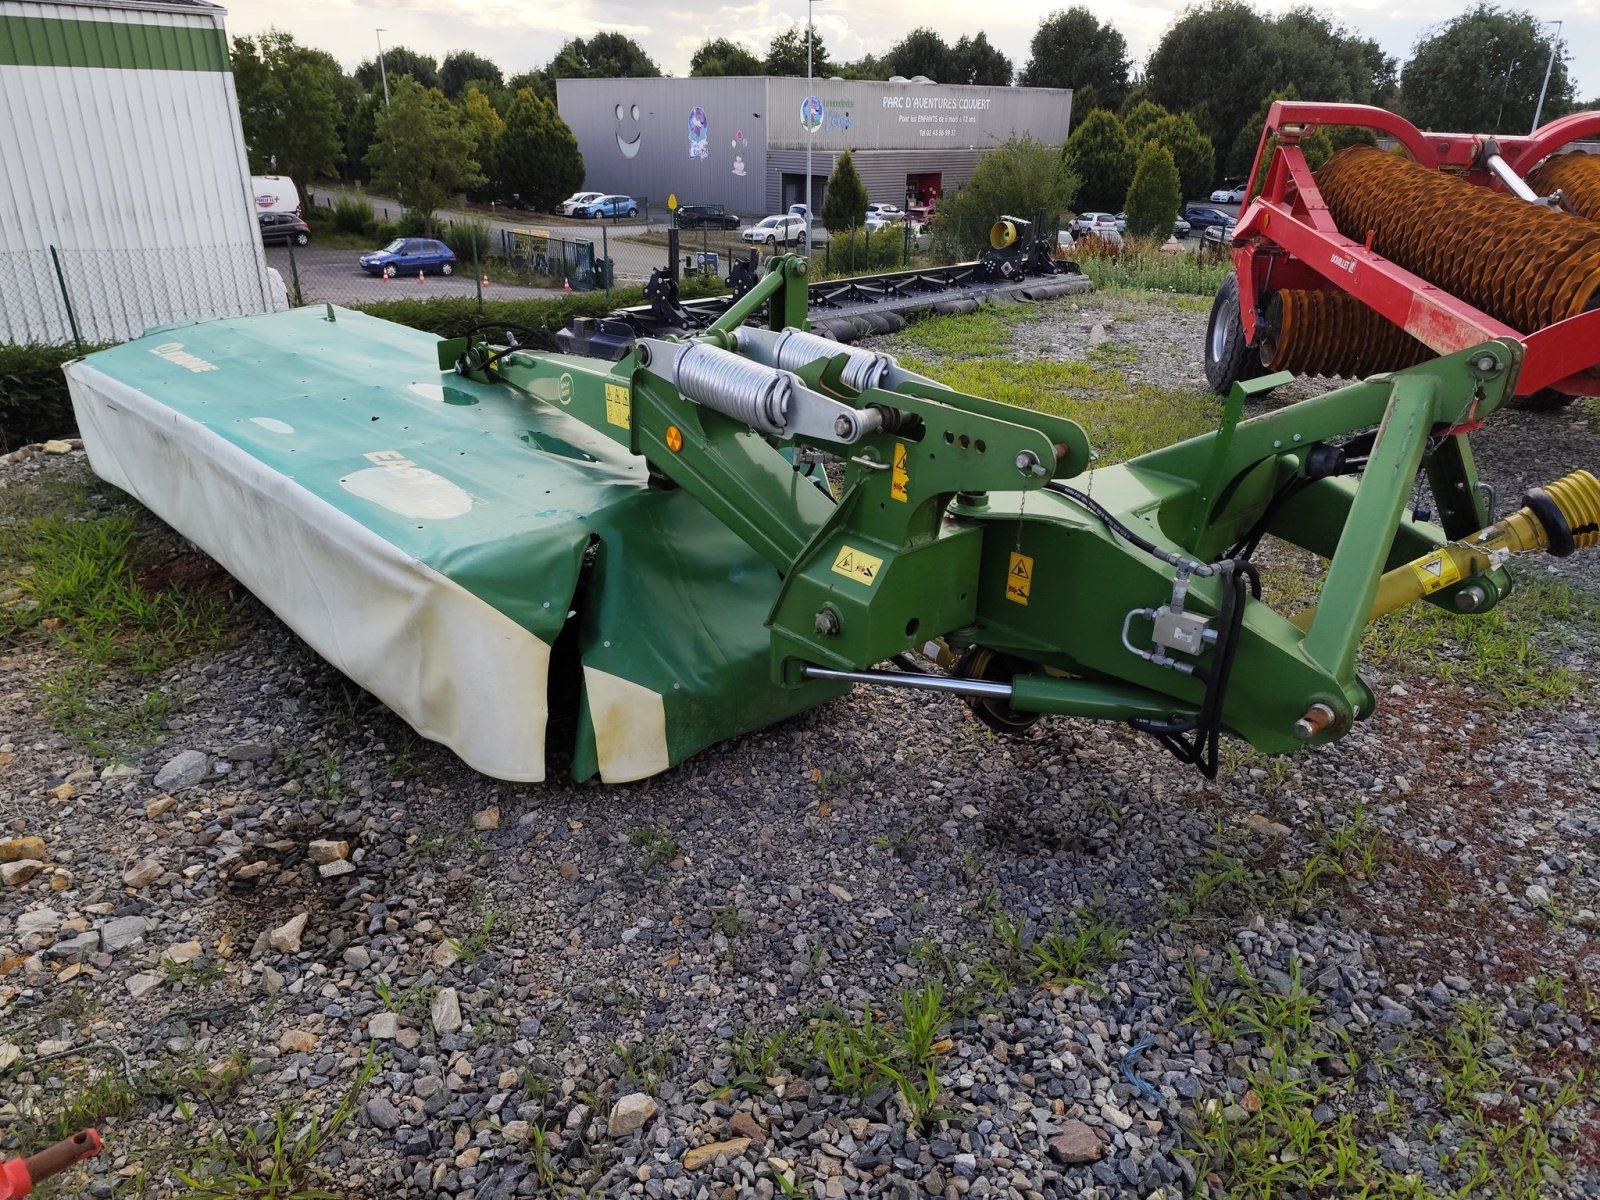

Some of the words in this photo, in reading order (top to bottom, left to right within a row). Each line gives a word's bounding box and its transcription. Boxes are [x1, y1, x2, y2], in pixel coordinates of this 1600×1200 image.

[882, 96, 904, 108] PARC
[905, 97, 957, 110] D'AVENTURES
[958, 98, 991, 110] COUVERT
[899, 115, 910, 123] Pour
[917, 115, 938, 123] ENFANTS
[926, 129, 932, 137] 02
[932, 129, 938, 137] 43
